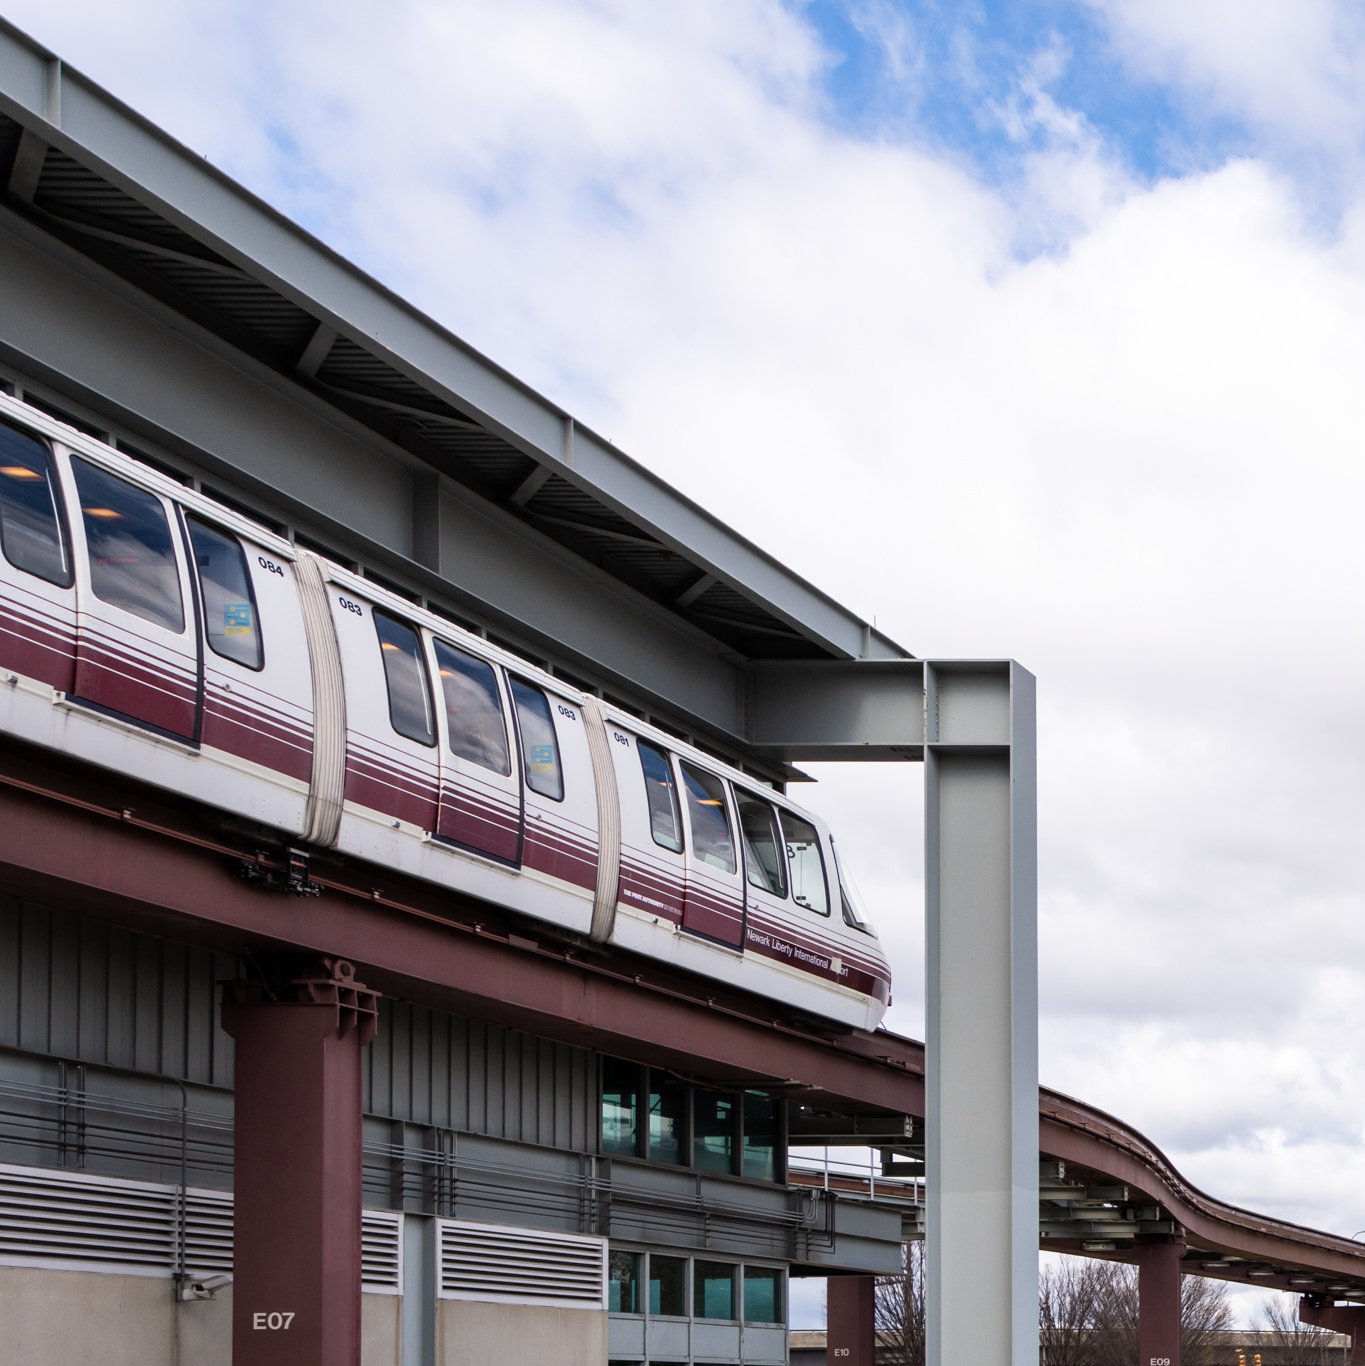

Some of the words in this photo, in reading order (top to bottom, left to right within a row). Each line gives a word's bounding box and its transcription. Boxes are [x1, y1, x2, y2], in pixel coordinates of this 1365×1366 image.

[258, 556, 284, 577] 084
[339, 597, 362, 616] 083
[558, 705, 576, 720] 083
[614, 732, 630, 747] 081
[746, 929, 770, 947] Newark
[771, 938, 793, 957] Liberty
[794, 947, 829, 969] International
[253, 1312, 296, 1330] E07
[834, 1348, 850, 1357] E10
[1150, 1357, 1171, 1366] E09
